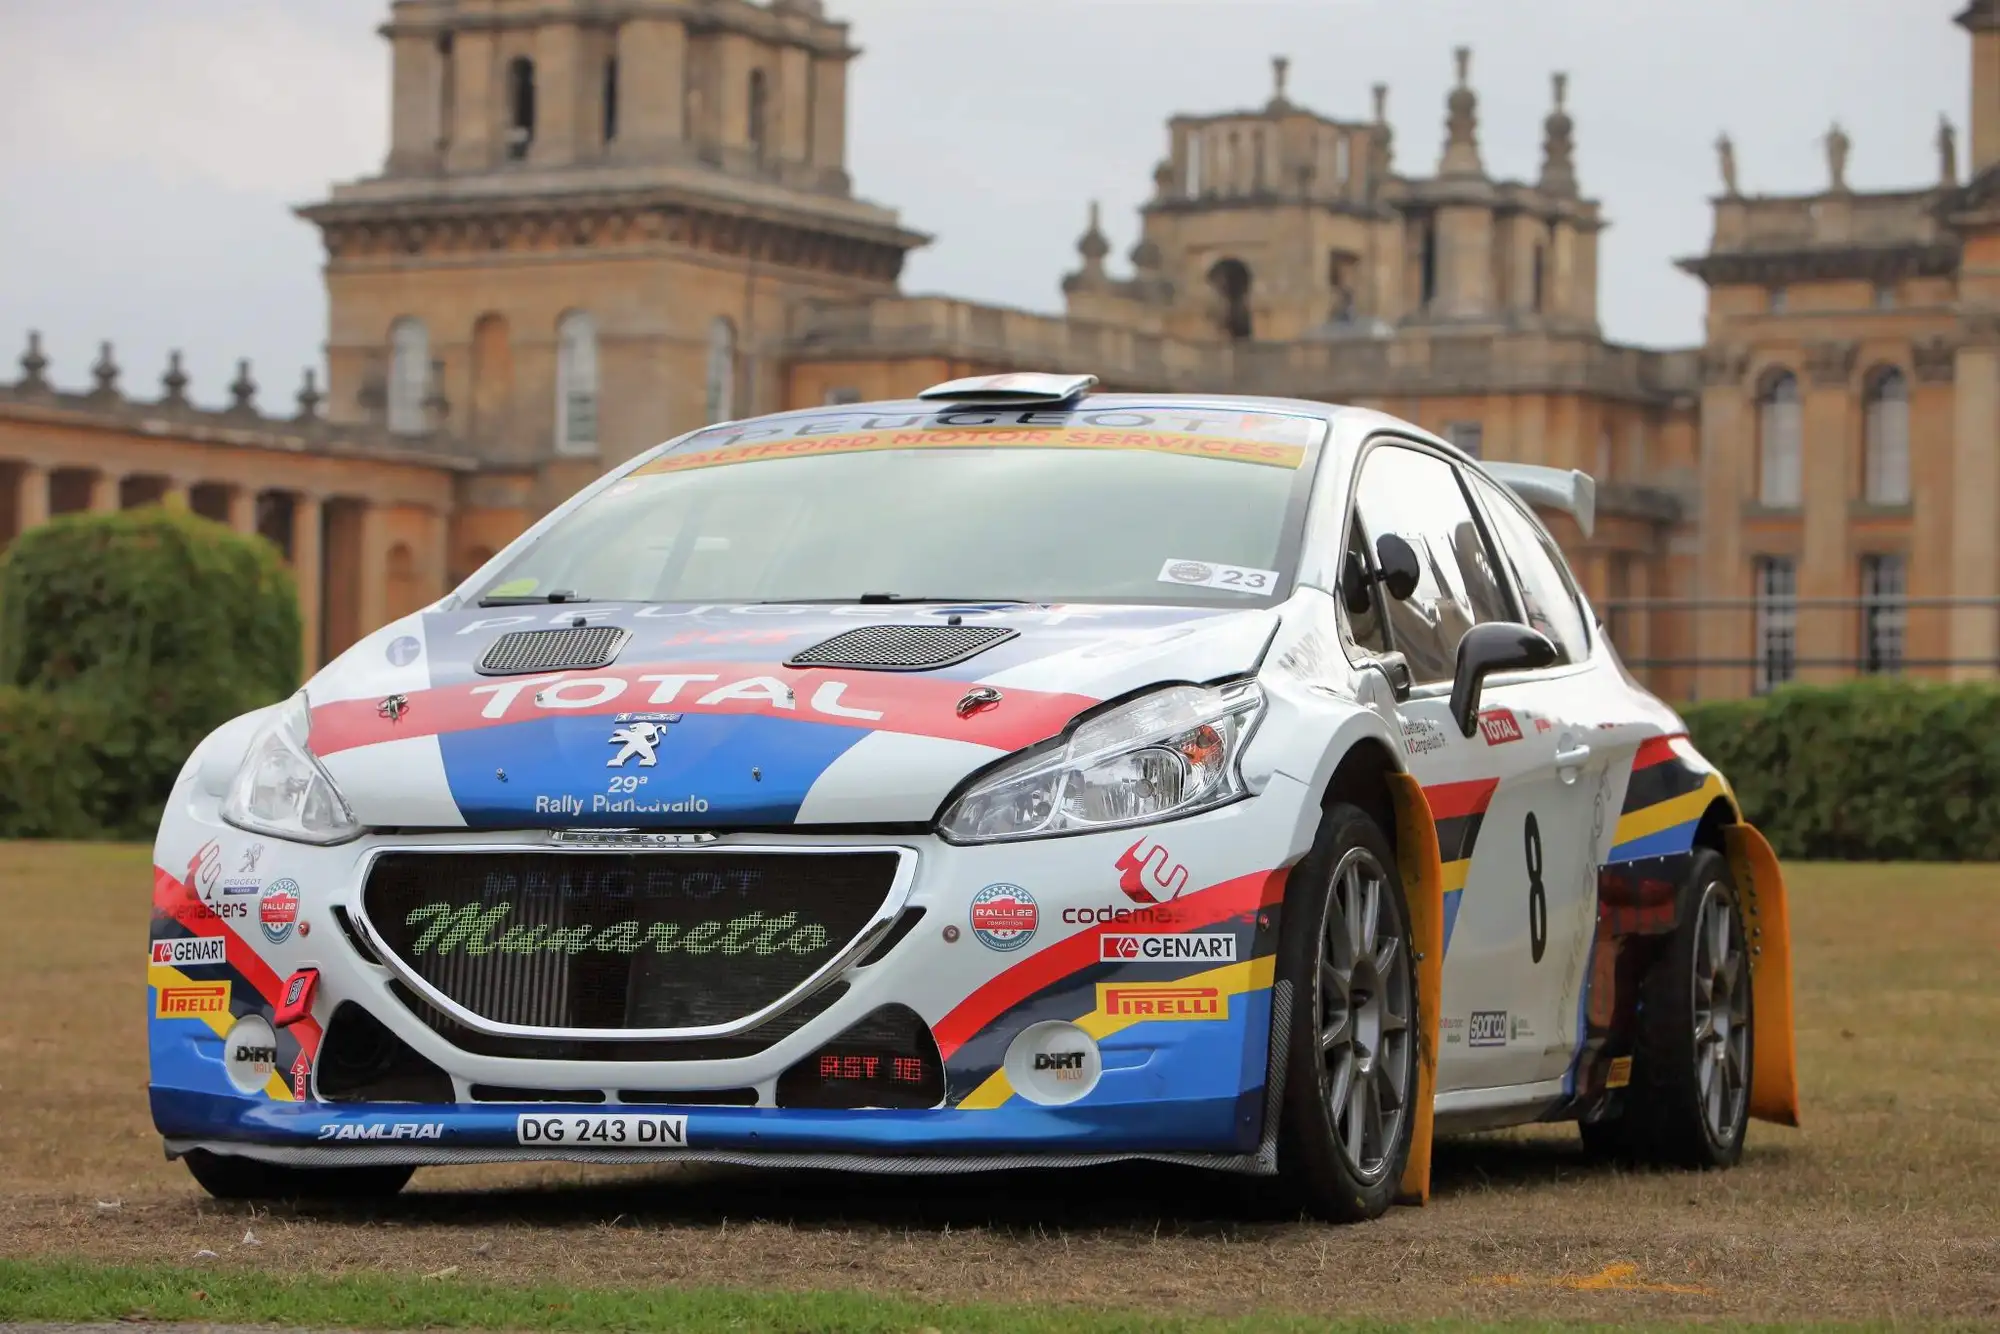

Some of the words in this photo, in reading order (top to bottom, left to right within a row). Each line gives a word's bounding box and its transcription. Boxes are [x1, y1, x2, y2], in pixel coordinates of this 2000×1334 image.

[722, 412, 1230, 446] PEUGEOT
[892, 431, 1051, 446] MOTOR
[1066, 431, 1288, 459] SERVICES
[1220, 569, 1267, 588] 23
[470, 673, 883, 721] TOTAL
[1480, 716, 1518, 742] TOTAL
[535, 795, 584, 816] Rally
[576, 835, 683, 843] PEUGEOT
[224, 878, 262, 886] PEUGEOT
[483, 867, 765, 899] PEUGEOT
[1524, 811, 1547, 964] 8
[174, 940, 224, 961] GENART
[1142, 937, 1234, 958] GENART
[160, 986, 226, 1013] PIRELLI
[1105, 987, 1219, 1015] PIRELLI
[1470, 1014, 1506, 1046] sparco
[296, 1063, 305, 1092] TOW
[1056, 1069, 1084, 1081] RALLY
[522, 1118, 565, 1142] DG
[576, 1119, 627, 1143] 243
[637, 1120, 683, 1143] DN
